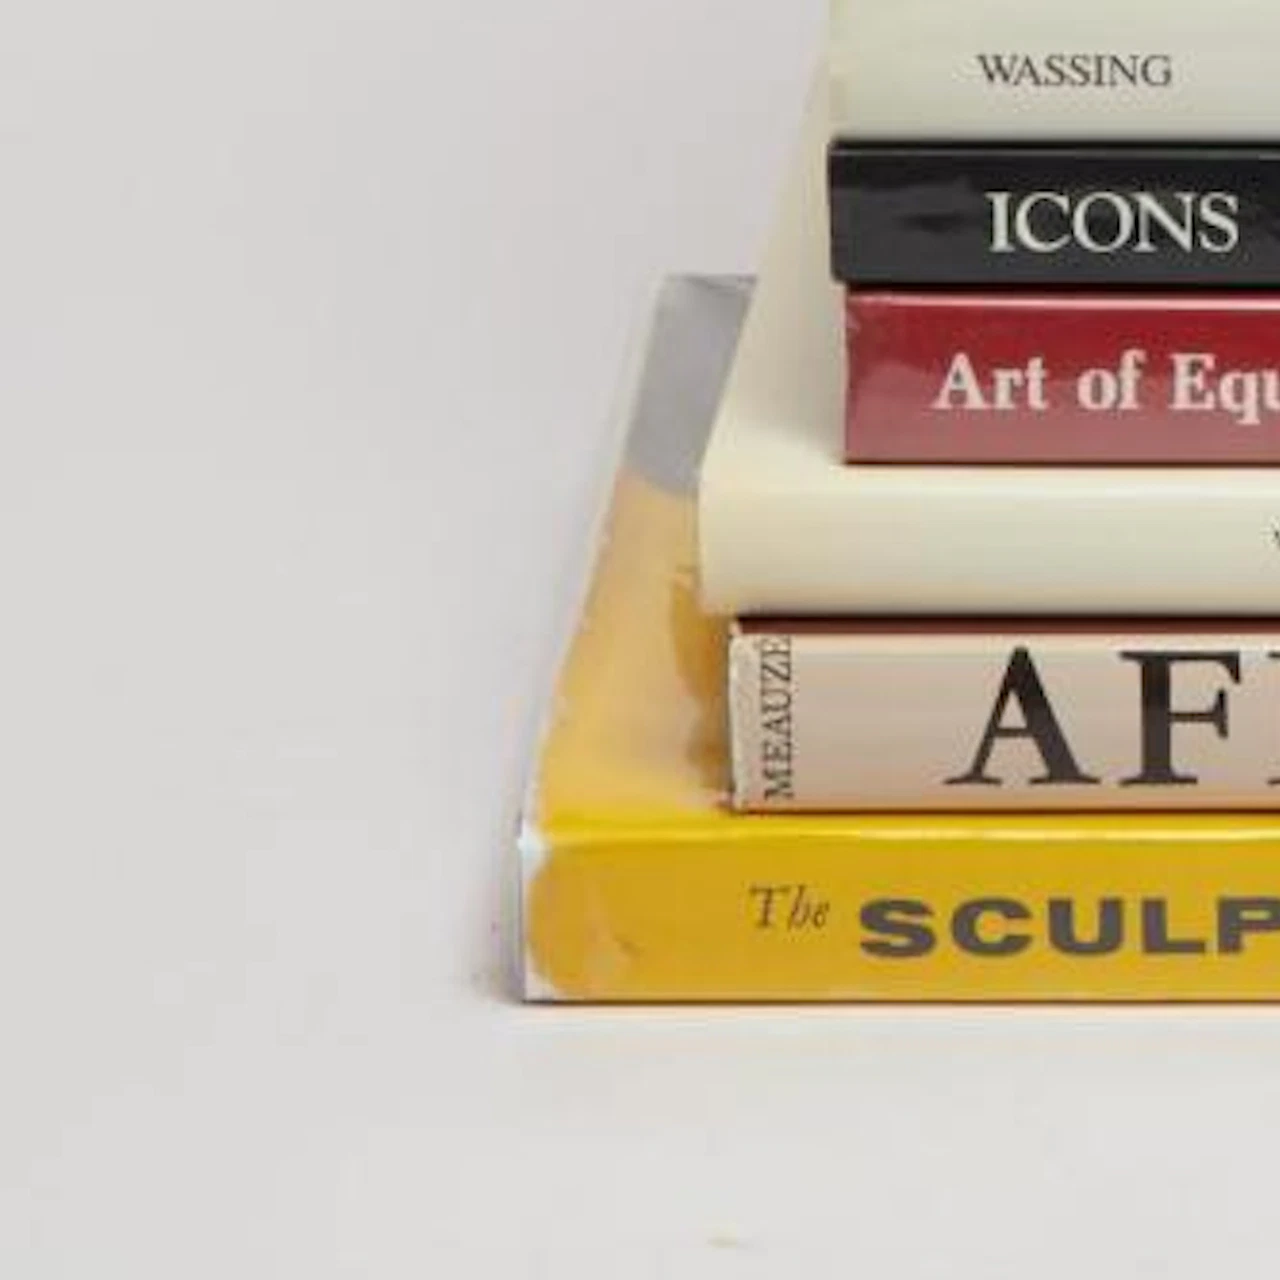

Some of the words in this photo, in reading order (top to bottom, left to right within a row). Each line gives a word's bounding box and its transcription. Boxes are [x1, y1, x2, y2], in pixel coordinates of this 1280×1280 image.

[977, 52, 1173, 89] WASSING
[986, 190, 1240, 255] ICONS
[933, 351, 1050, 413] Art
[1075, 348, 1146, 413] of
[747, 882, 831, 933] The
